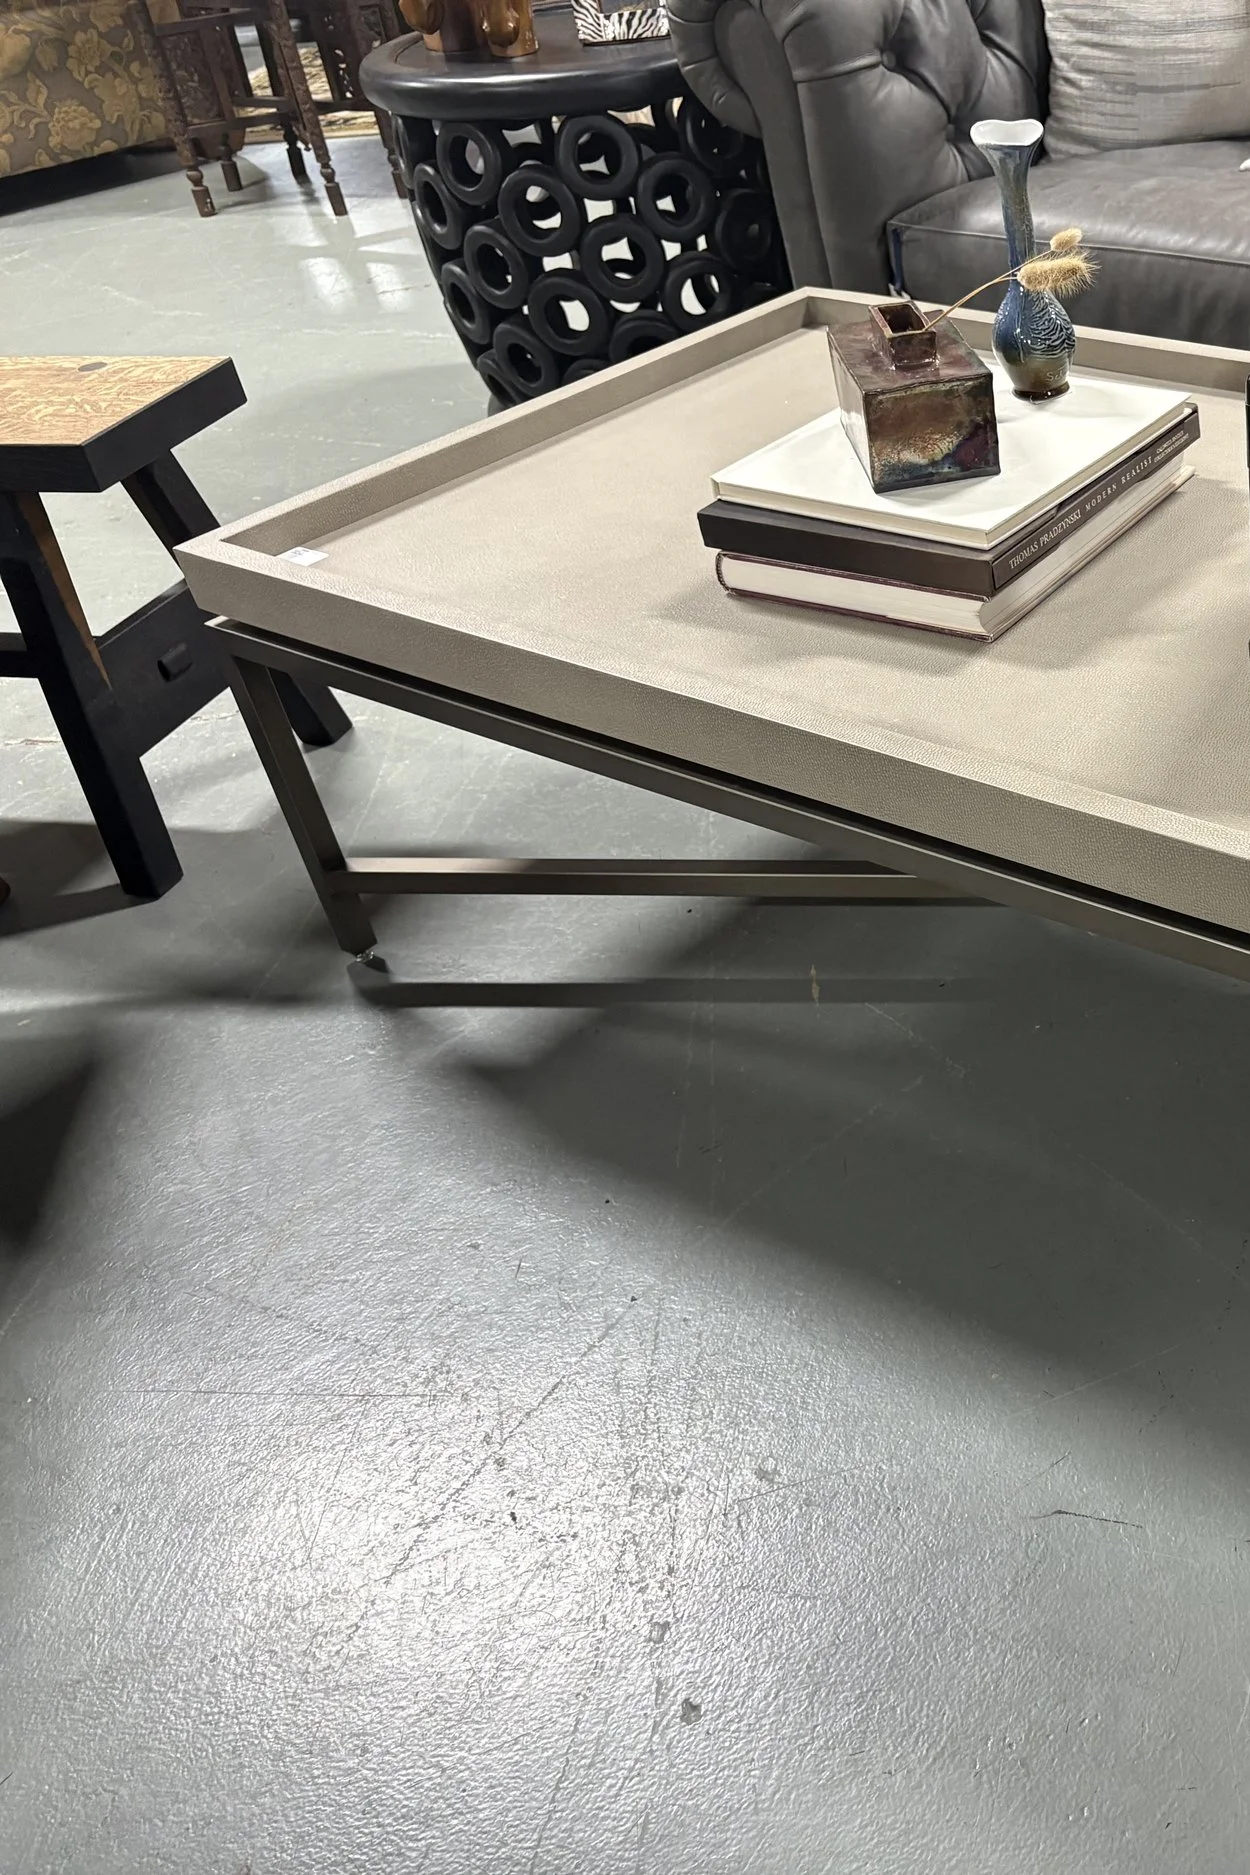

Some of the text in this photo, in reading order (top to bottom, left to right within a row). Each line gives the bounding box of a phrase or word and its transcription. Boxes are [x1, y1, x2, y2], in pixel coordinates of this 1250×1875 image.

[1008, 455, 1153, 570] THOMAS PRADZYNSKI MODERN REALIST
